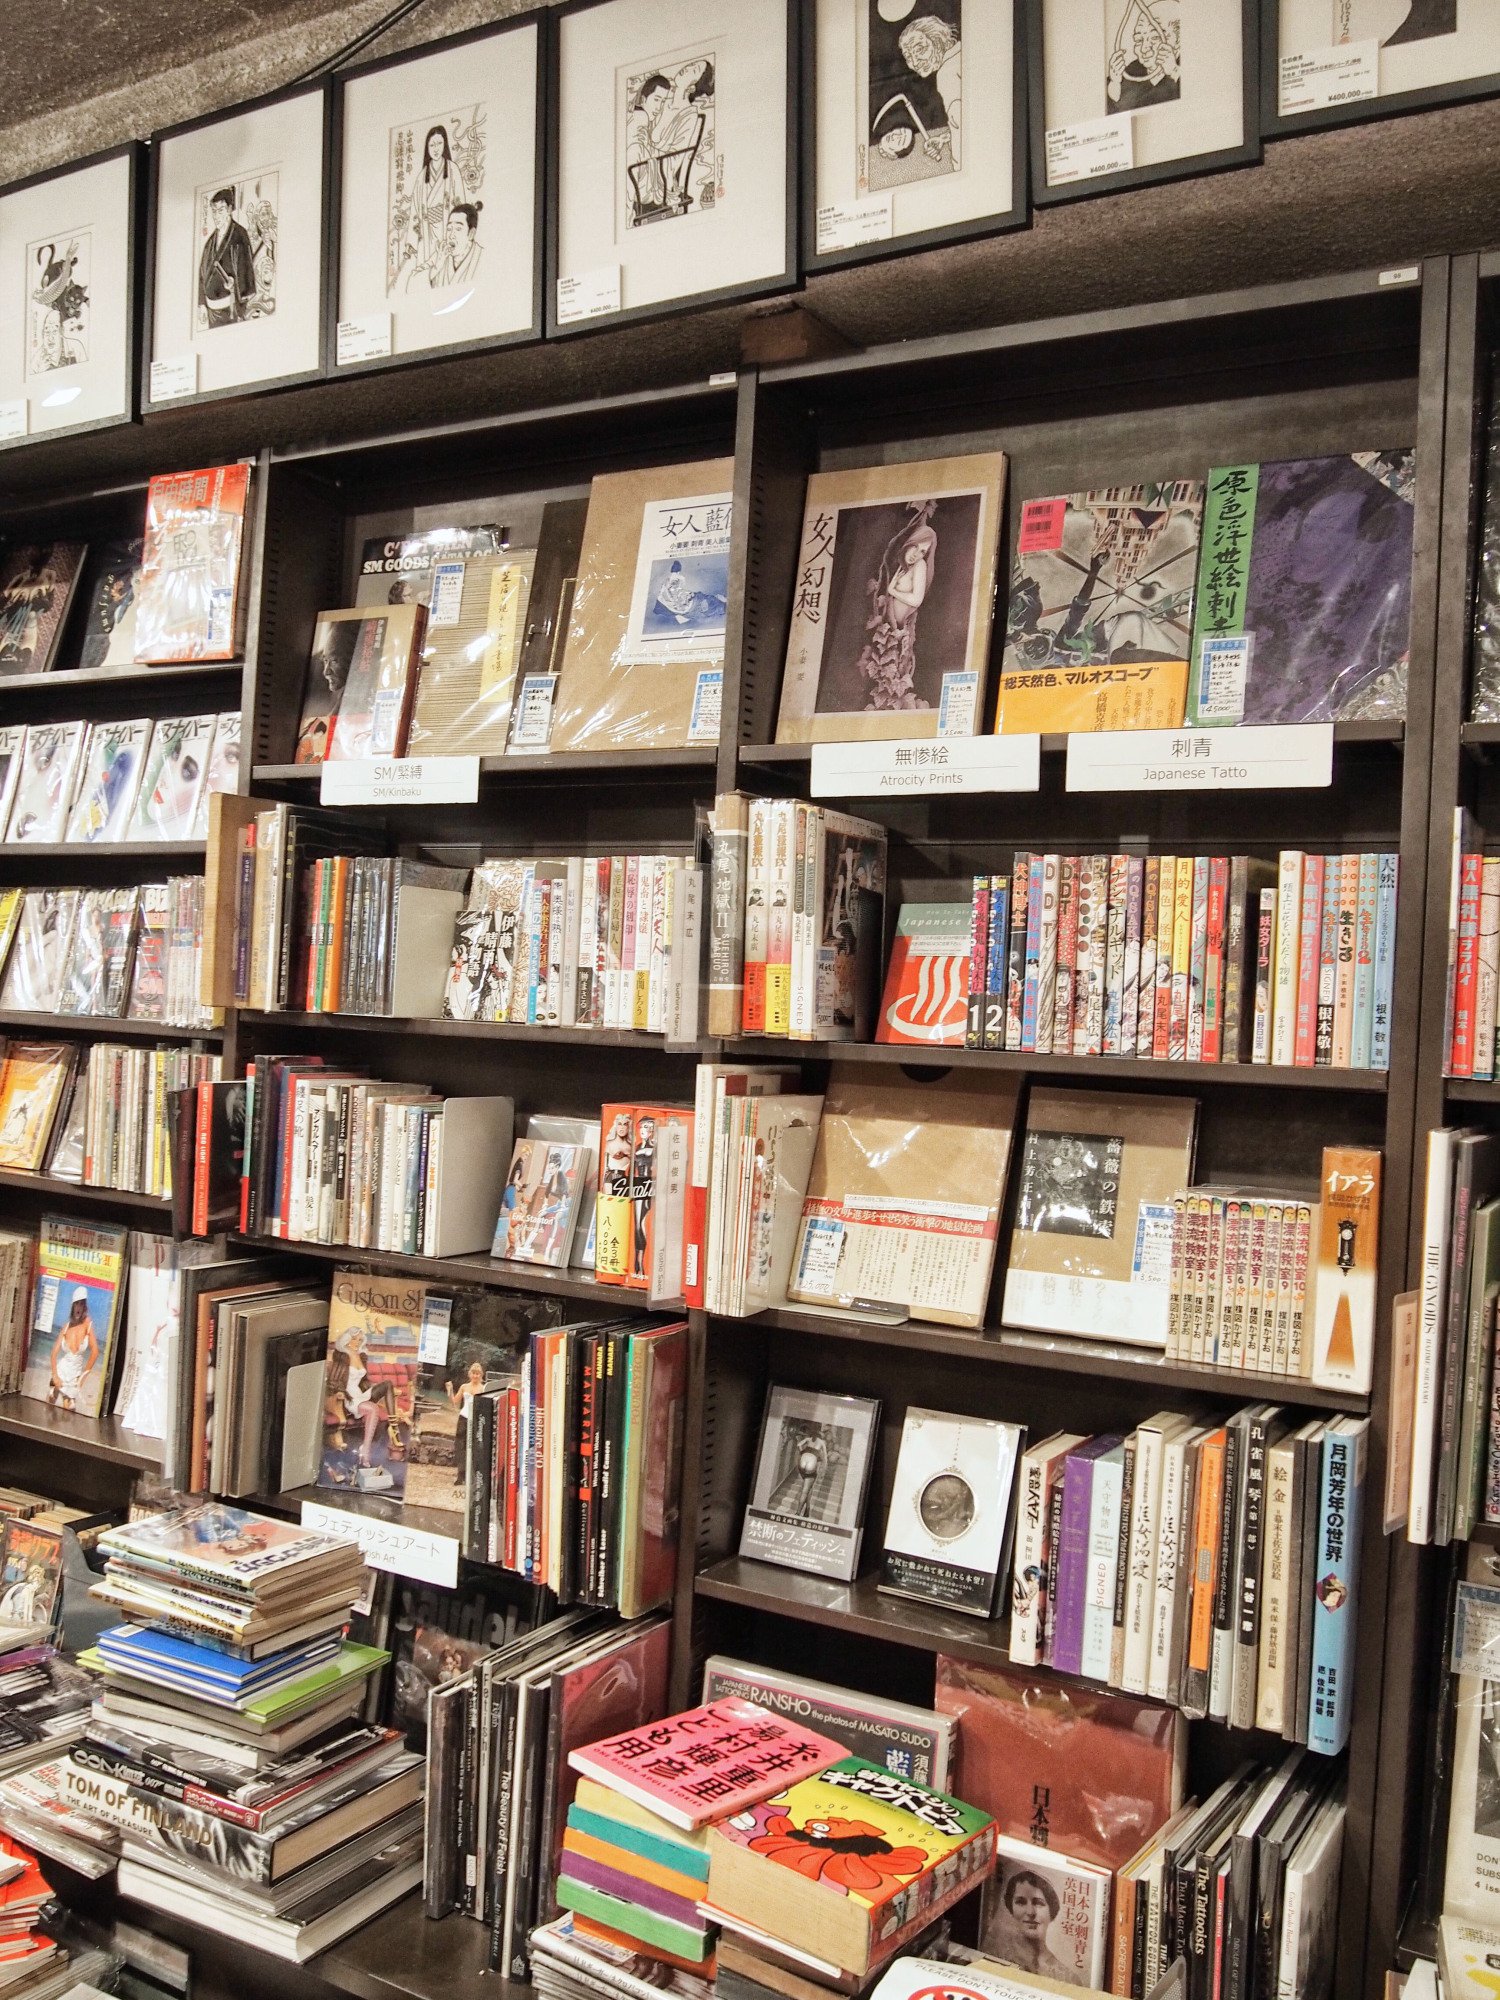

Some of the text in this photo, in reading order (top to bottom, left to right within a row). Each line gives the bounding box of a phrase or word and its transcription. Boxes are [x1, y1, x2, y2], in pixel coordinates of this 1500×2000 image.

[1328, 90, 1361, 101] ¥400,000
[1090, 162, 1119, 173] ¥400,000
[363, 556, 430, 574] SM GOODS
[796, 512, 834, 625] 女人幻想
[374, 765, 422, 781] SM/緊縛
[895, 747, 949, 766] 無惨絵
[1144, 766, 1248, 783] Japanese Tatto
[1172, 738, 1213, 758] 刺青
[373, 787, 421, 797] SM/Kinbaku
[880, 773, 963, 787] Atrocity Prints
[685, 876, 696, 939] 丸尾末広
[1011, 863, 1029, 927] 犬神博士
[1158, 861, 1174, 952] 薔薇色ノ怪物
[1175, 861, 1190, 923] 月的愛人
[499, 914, 516, 949] 伊藤
[904, 918, 961, 927] Japanese
[1259, 915, 1272, 967] 妖女ダーラ
[1338, 910, 1355, 963] 生きる
[713, 937, 722, 971] MARUO
[721, 933, 731, 975] SUEHIRO
[1087, 985, 1101, 1038] 丸尾末広
[1322, 968, 1331, 1002] SIGNED
[969, 1005, 980, 1032] 1
[985, 1004, 1004, 1032] 2
[1155, 994, 1169, 1047] 丸尾末広
[1317, 1006, 1333, 1050] 根本敬
[199, 1146, 207, 1164] LIGHT
[669, 1133, 682, 1194] 佐伯俊男
[1326, 1170, 1375, 1196] イアラ
[1171, 1213, 1185, 1268] 漂流教室
[1185, 1213, 1199, 1280] 漂流教室 2
[1196, 1215, 1210, 1282] 漂流教室 3
[1208, 1214, 1221, 1281] 漂流教室 4
[1224, 1219, 1239, 1284] 漂流教室 5
[1237, 1219, 1250, 1284] 漂流教室 6
[1251, 1219, 1265, 1286] 漂流教室 7
[1265, 1222, 1280, 1288] 漂流教室 8
[1280, 1223, 1295, 1290] 漂流教室 9
[1294, 1223, 1311, 1291] 漂流教室 10
[336, 1283, 399, 1313] Custom
[1423, 1244, 1439, 1335] THE GYNOIDS
[580, 1365, 592, 1441] MANARA
[536, 1407, 545, 1468] Histoire d'O
[1247, 1427, 1265, 1500] 孔雀風琴
[602, 1441, 610, 1498] Candid Camera
[1272, 1467, 1288, 1503] 絵金
[1325, 1443, 1348, 1563] 月岡芳年の世界
[318, 1514, 440, 1558] フェティッシュアート
[748, 1520, 847, 1558] 禁断のフェティッシュ
[598, 1561, 606, 1597] Schreiber
[1095, 1563, 1106, 1606] SIGNED
[715, 1684, 750, 1699] TATTOOING
[721, 1678, 751, 1693] JAPANESE
[750, 1686, 931, 1748] RANSHO the photos of MASATO SUDO
[594, 1748, 702, 1807] ONE DOZEN ADULT STORIES
[819, 1770, 968, 1836] ギャグトピア
[855, 1768, 961, 1818] 谷岡ヤスジの
[66, 1771, 213, 1847] TOM OF FINLAND
[66, 1795, 153, 1837] THE ART OF PLEASURE
[496, 1771, 511, 1875] The Beauty of Fetish
[1061, 1877, 1077, 1937] 英国王室
[1176, 1881, 1188, 1935] THAI MAGIC
[1196, 1866, 1210, 1955] The Tattooists
[1475, 1881, 1481, 1889] 4
[1075, 1882, 1091, 1969] 日本の刺青と
[1148, 1885, 1159, 1944] THE TATTOO
[914, 1963, 956, 1981] PLEASE
[957, 1977, 992, 1992] DON'T
[1117, 1935, 1127, 1971] SACRED
